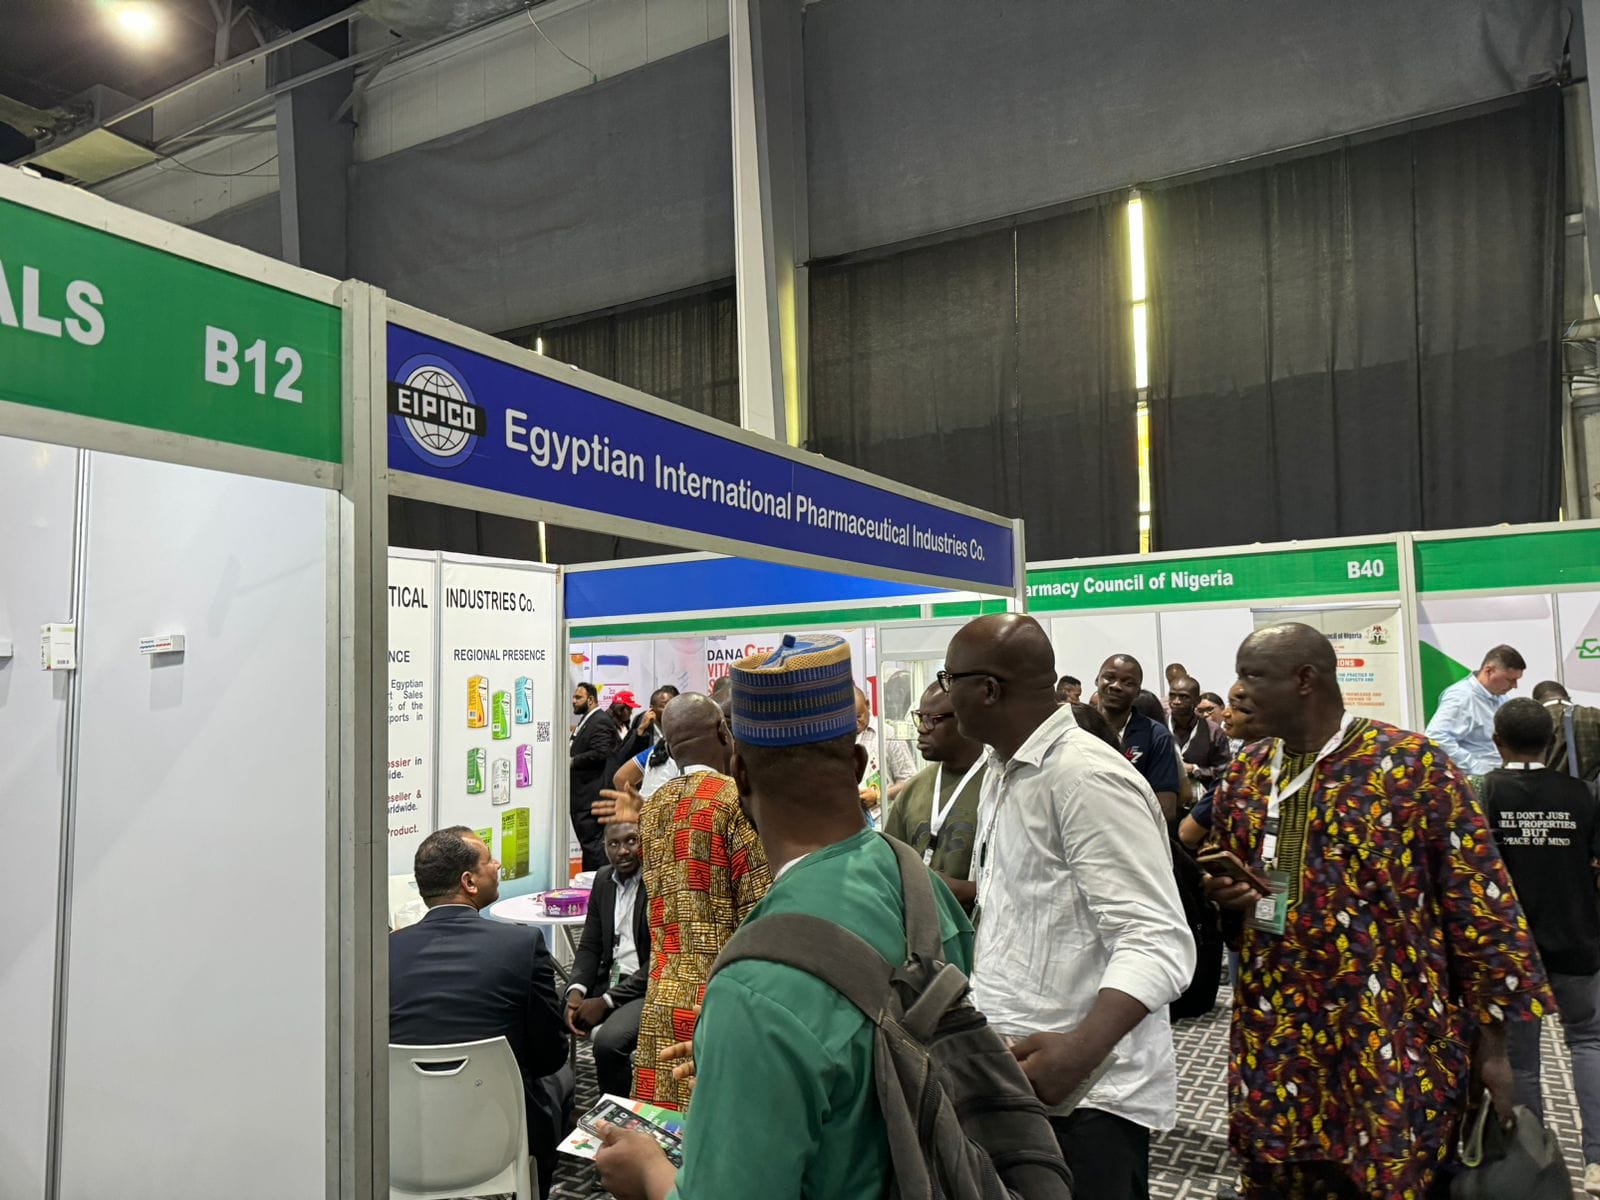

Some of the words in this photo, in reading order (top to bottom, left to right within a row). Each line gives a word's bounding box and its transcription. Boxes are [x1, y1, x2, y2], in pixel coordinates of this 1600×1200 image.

[204, 324, 303, 404] B12
[398, 387, 476, 431] EIPICO
[505, 408, 645, 483] Egyptian
[655, 454, 791, 521] International
[796, 495, 909, 547] Pharmaceutical
[912, 524, 968, 558] Industries
[970, 539, 985, 562] Co.
[1084, 573, 1144, 594] Council
[1149, 572, 1167, 589] of
[1171, 569, 1234, 592] Nigeria
[1347, 559, 1384, 579] B40
[388, 585, 428, 608] TICAL
[446, 587, 516, 611] INDUSTRIES
[519, 593, 535, 612] Co.
[454, 649, 501, 661] REGIONAL
[502, 649, 545, 661] PRESENCE
[391, 679, 424, 691] Egyptian
[403, 690, 424, 700] Sales
[398, 701, 406, 711] of
[411, 701, 424, 710] the
[416, 712, 424, 721] in
[415, 756, 422, 765] in
[1500, 811, 1514, 820] WE
[1516, 811, 1545, 820] DON'T
[1546, 811, 1571, 820] JUST
[388, 824, 419, 837] roduct.
[1518, 820, 1577, 830] PROPERTIES
[1521, 828, 1549, 837] BUT
[1532, 837, 1546, 846] OF
[1547, 837, 1571, 847] MIND
